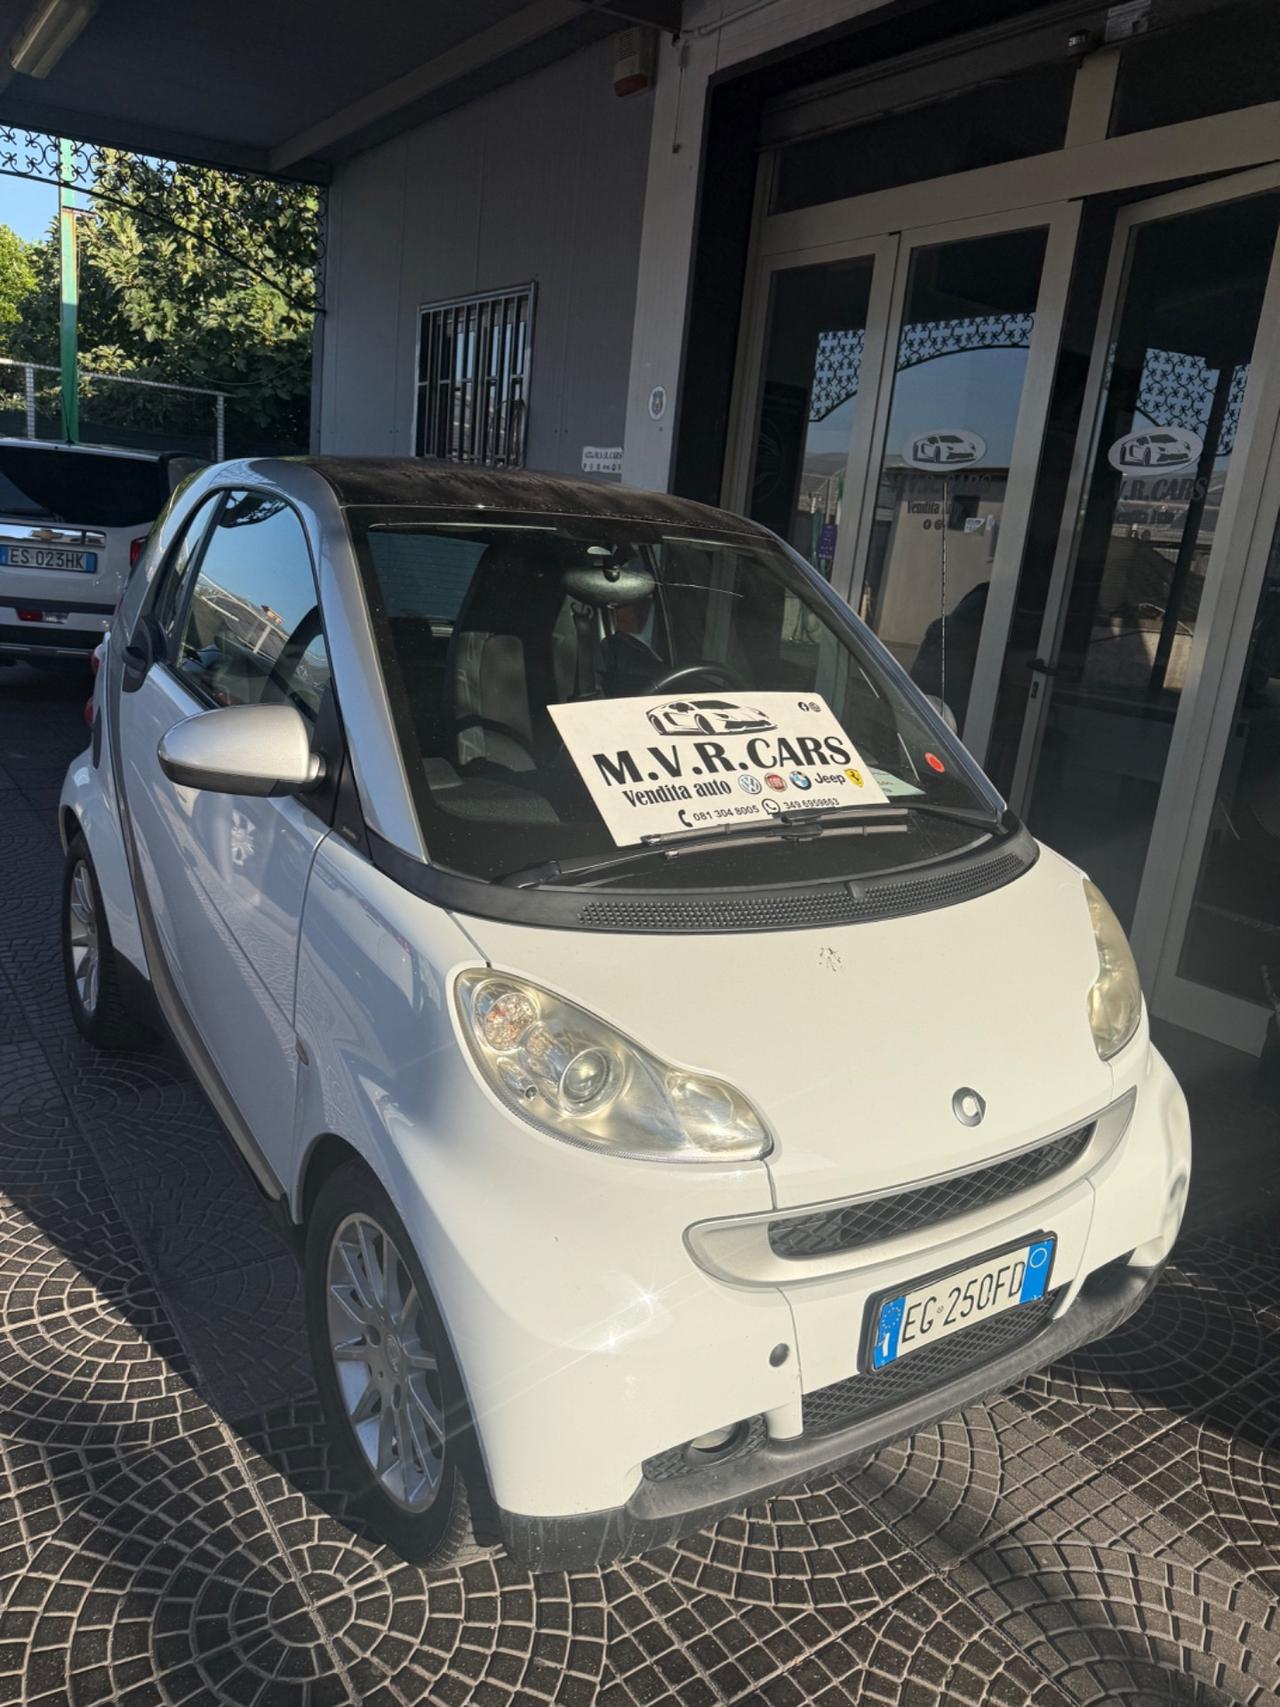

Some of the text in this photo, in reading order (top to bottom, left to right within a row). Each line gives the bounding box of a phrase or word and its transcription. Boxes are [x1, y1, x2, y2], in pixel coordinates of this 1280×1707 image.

[10, 548, 85, 570] ES 023HK
[814, 772, 846, 786] Jeep
[622, 778, 732, 808] Vendita auto
[692, 804, 760, 821] 081 304 8005
[902, 1260, 1026, 1344] EG 250FD
